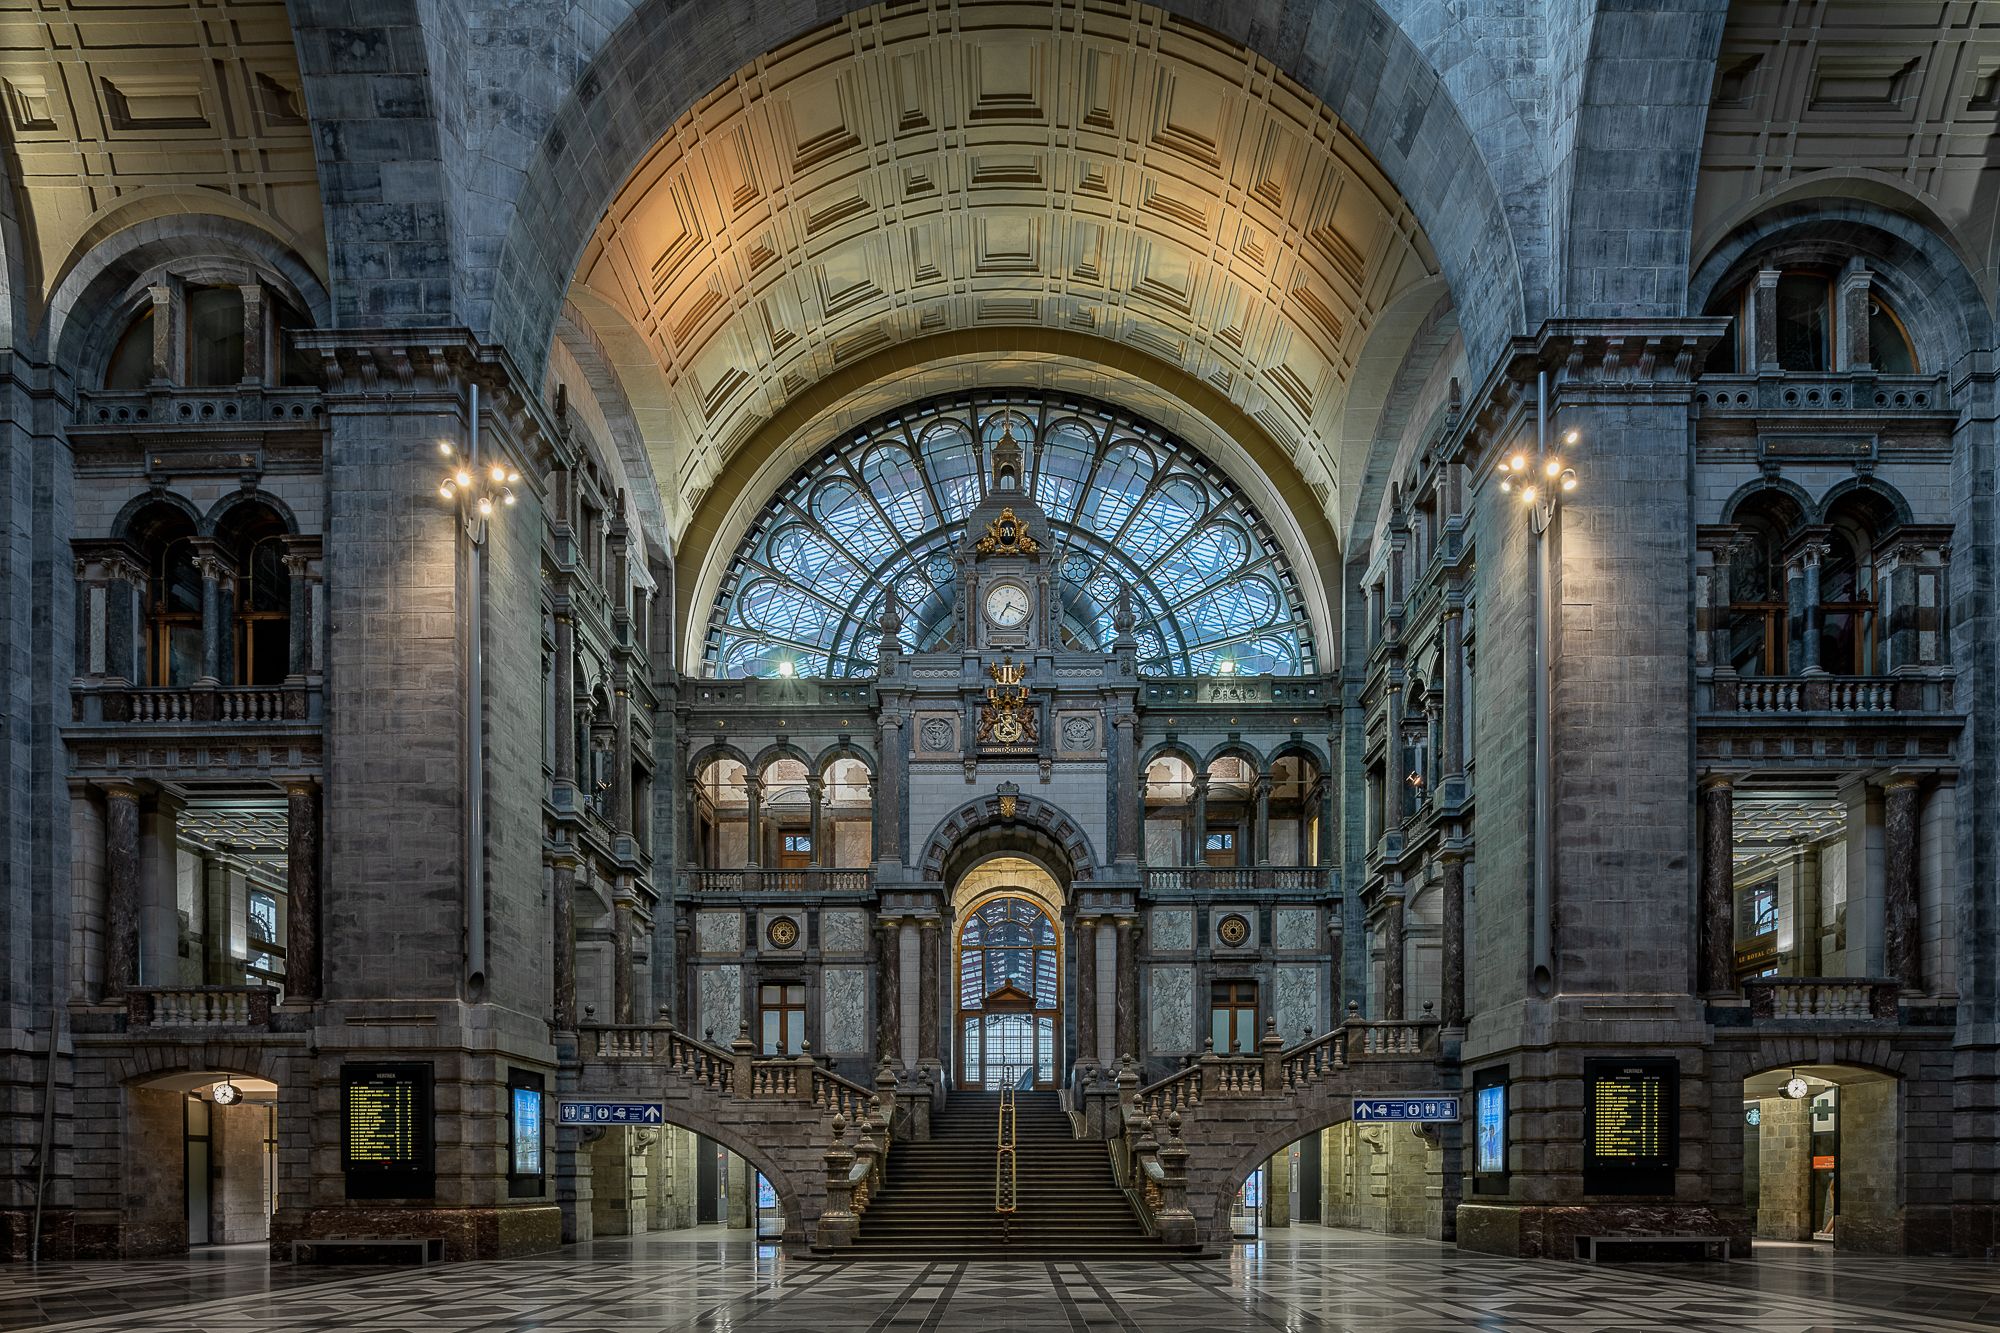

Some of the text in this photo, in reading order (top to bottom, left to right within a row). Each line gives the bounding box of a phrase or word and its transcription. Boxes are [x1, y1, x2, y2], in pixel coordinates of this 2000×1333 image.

[1000, 526, 1016, 537] PAX
[1747, 951, 1765, 960] ROYAL
[517, 1100, 535, 1111] HELLO
